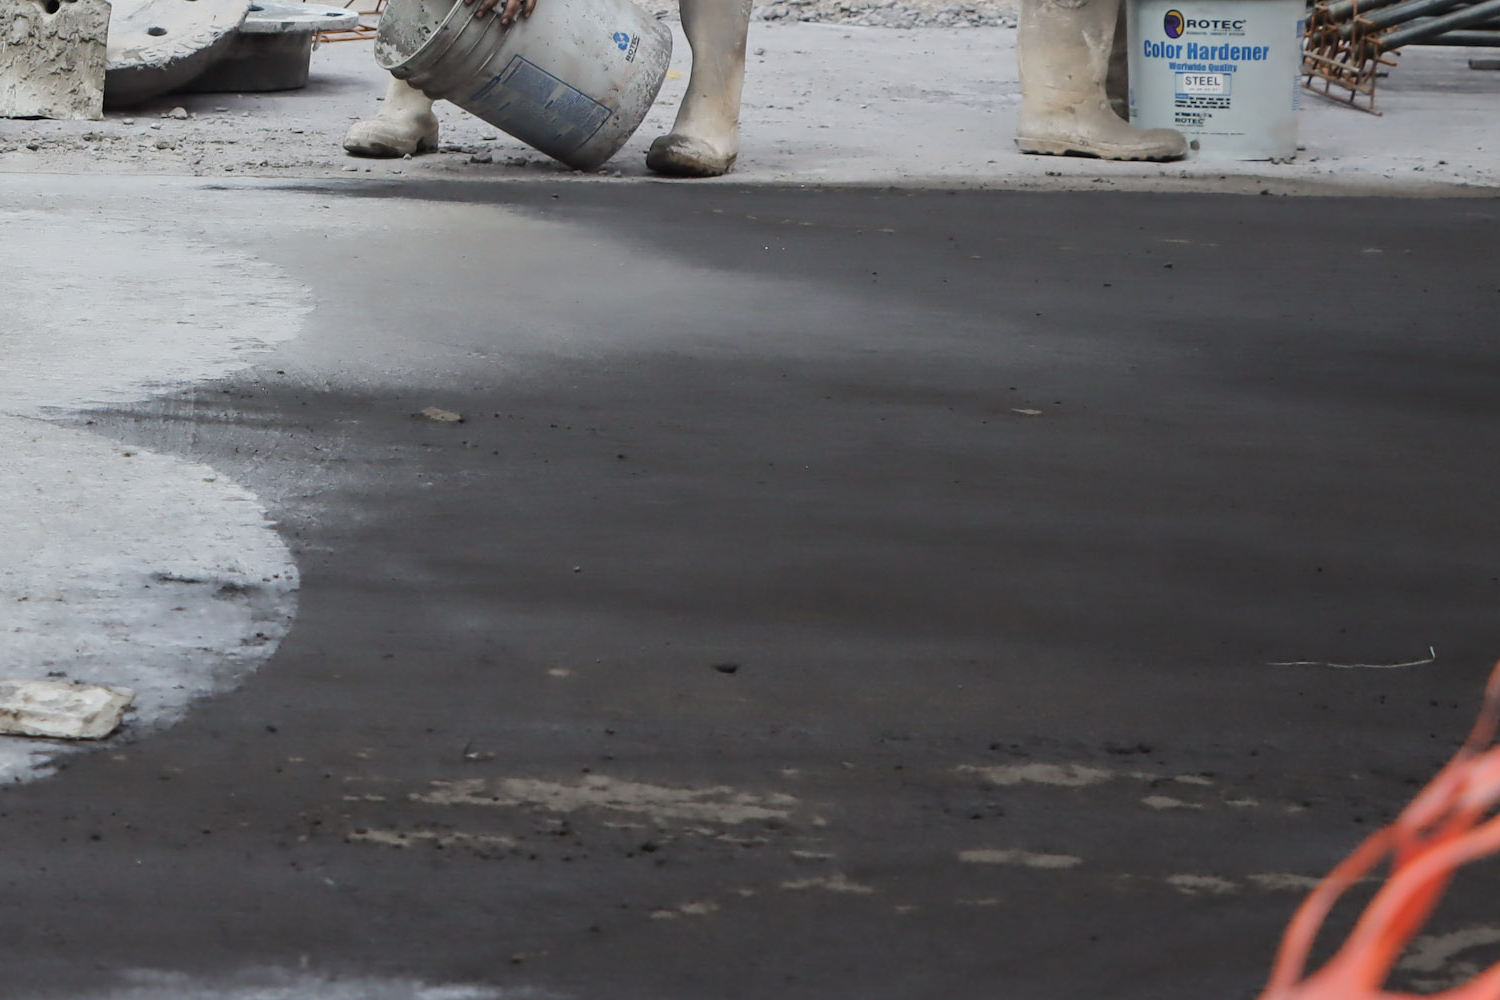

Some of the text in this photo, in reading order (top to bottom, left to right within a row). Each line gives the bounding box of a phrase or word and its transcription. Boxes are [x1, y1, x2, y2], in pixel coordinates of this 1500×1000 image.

[1187, 19, 1244, 30] ROTEC
[625, 32, 638, 62] ROTEC
[1144, 40, 1270, 61] Color Hardener
[1208, 63, 1238, 73] Quality
[1185, 76, 1221, 86] STEEL
